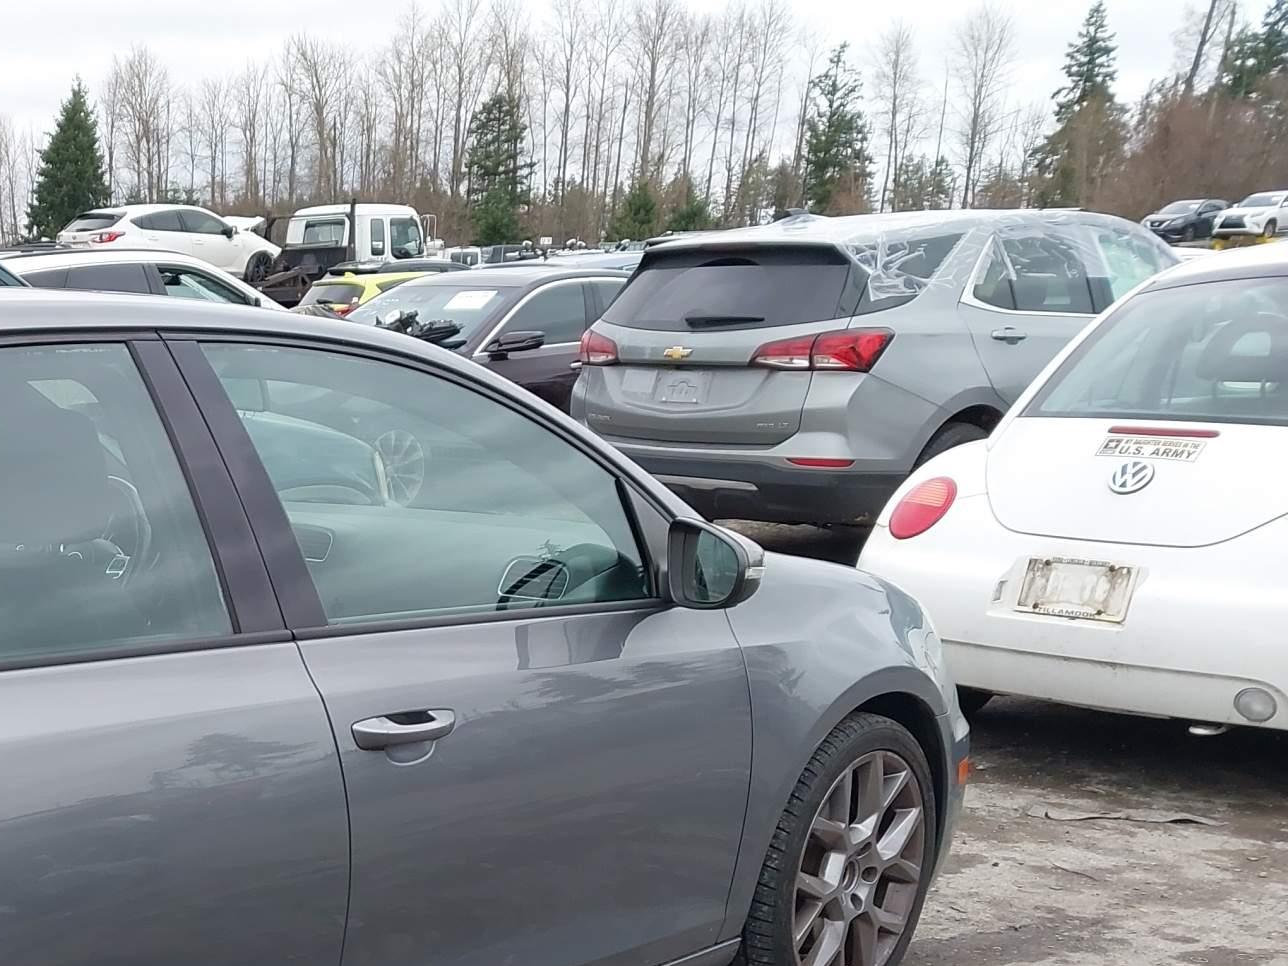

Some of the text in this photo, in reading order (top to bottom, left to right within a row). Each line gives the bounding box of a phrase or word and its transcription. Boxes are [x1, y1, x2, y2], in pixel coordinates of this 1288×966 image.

[1118, 445, 1197, 459] U.S. ARMY
[1038, 606, 1097, 619] TILLAMOOK
